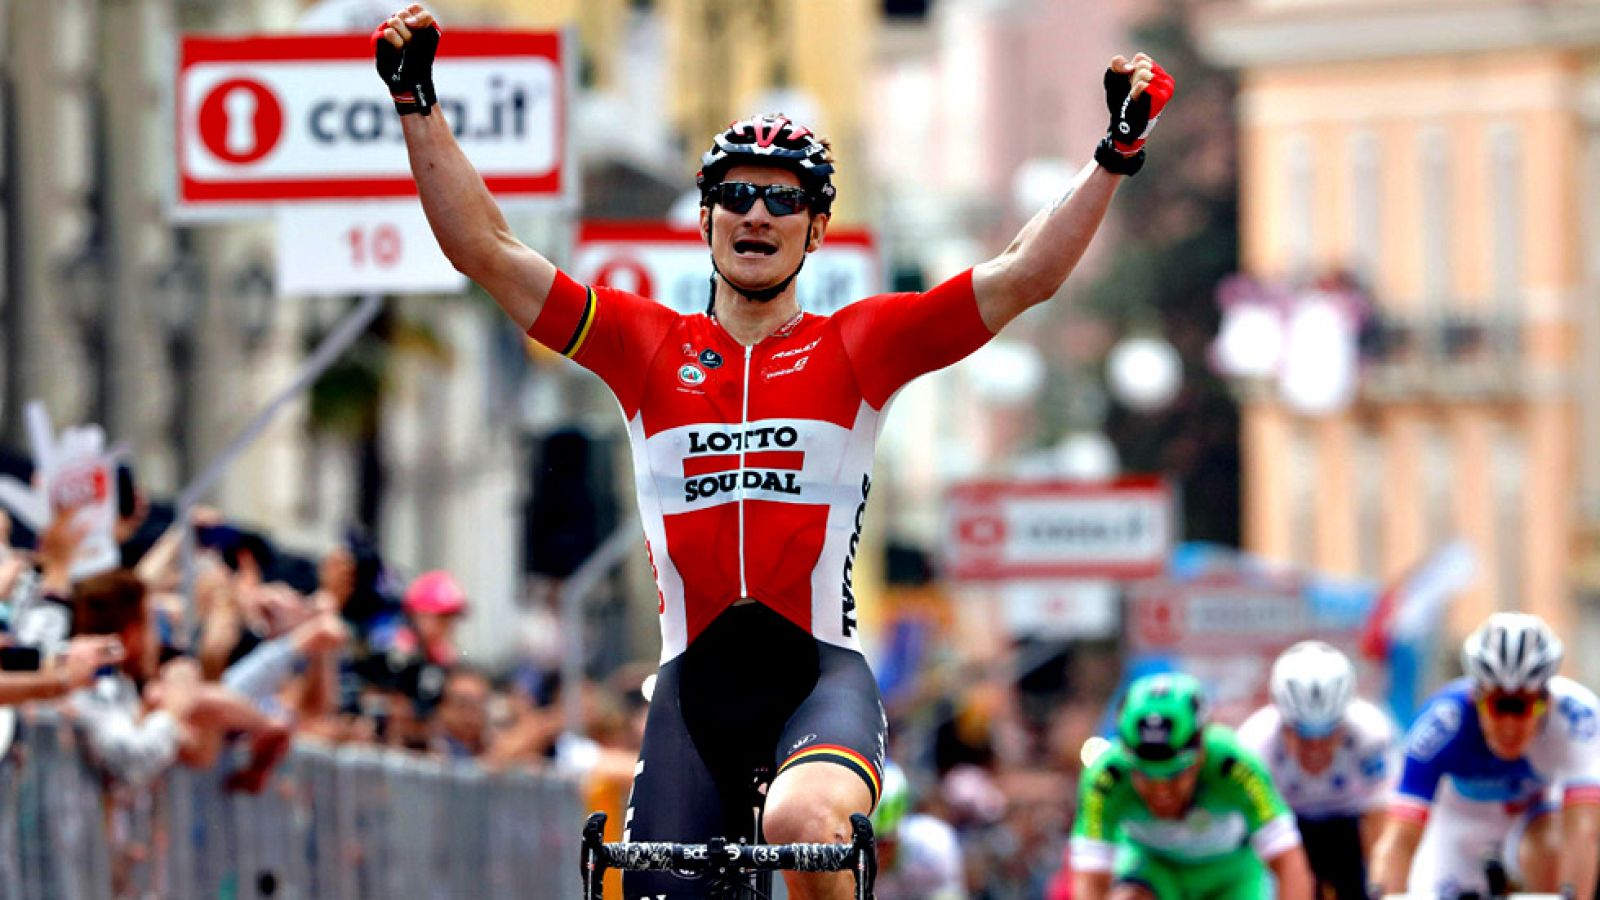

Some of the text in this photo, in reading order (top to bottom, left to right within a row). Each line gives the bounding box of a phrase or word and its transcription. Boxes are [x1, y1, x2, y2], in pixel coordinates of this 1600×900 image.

[347, 224, 402, 267] 10
[688, 425, 798, 454] LOTTO
[684, 471, 802, 503] SOUDAL
